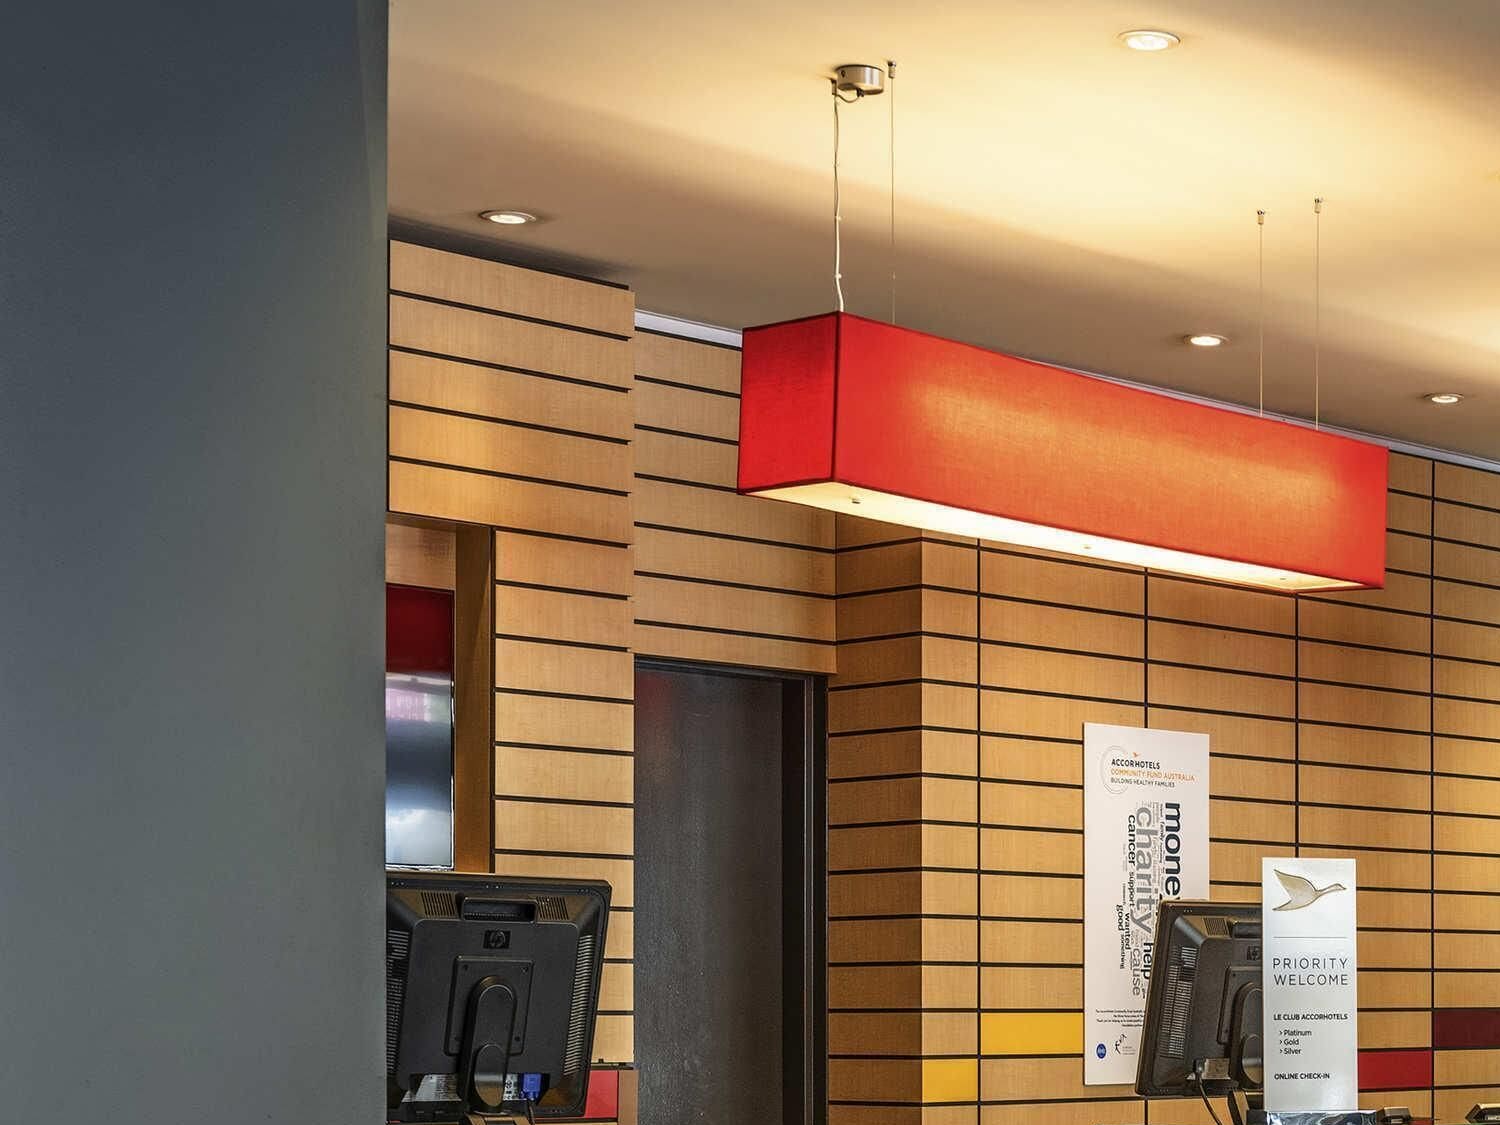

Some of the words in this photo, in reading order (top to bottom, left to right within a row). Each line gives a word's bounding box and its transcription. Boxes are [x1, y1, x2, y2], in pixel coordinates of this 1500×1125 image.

[1111, 759, 1160, 770] ACCORHOTELS
[1111, 768, 1145, 777] COMMUNITY
[1147, 771, 1162, 779] FUND
[1163, 772, 1195, 782] AUSTRALIA
[1111, 777, 1133, 785] BUILDING
[1155, 780, 1175, 788] FAMILIES
[1128, 815, 1136, 866] cancer
[1165, 803, 1181, 898] mone
[1131, 807, 1158, 934] charity
[1116, 904, 1124, 931] good
[1141, 943, 1154, 980] help
[1272, 958, 1348, 969] PRIORITY
[1132, 949, 1140, 996] cause
[1273, 974, 1349, 986] WELCOME
[1273, 1013, 1282, 1021] LE
[1283, 1013, 1300, 1021] CLUB
[1301, 1013, 1348, 1021] ACCORHOTELS
[1299, 1072, 1330, 1080] CHECK-IN
